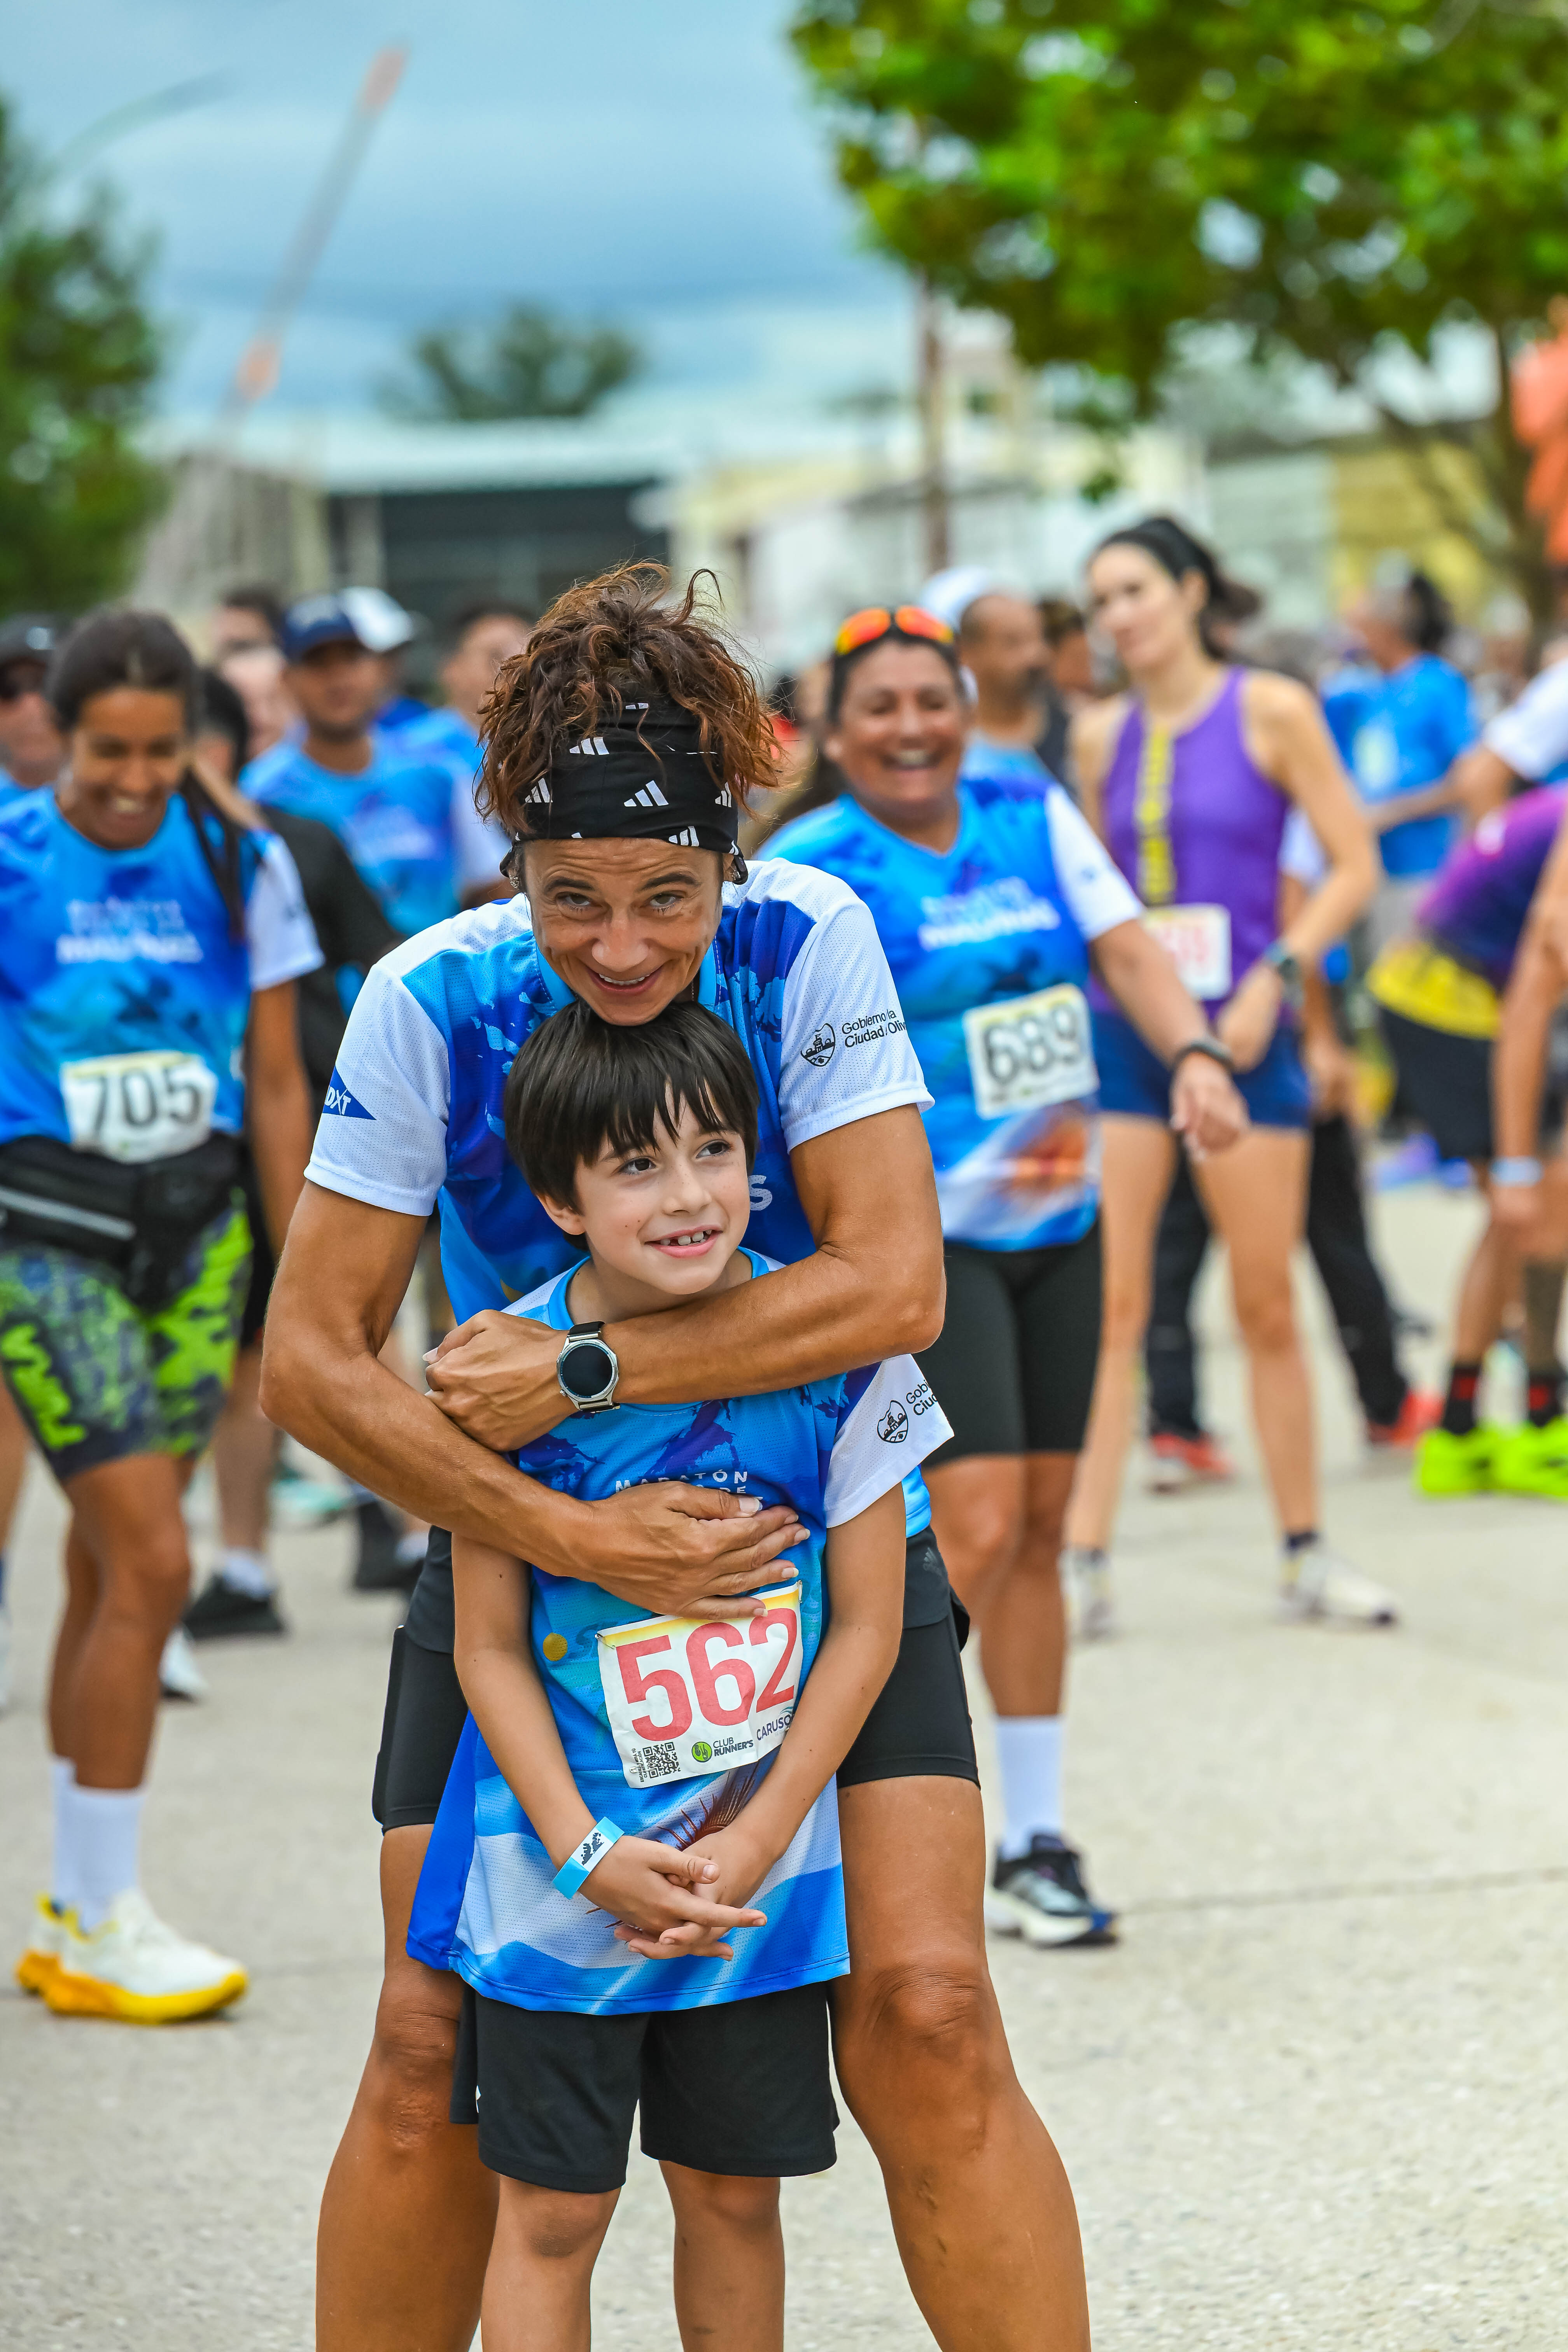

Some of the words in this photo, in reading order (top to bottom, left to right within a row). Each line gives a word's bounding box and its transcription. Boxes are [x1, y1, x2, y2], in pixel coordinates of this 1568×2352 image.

[842, 1013, 886, 1034] Gobierno
[845, 1025, 885, 1048] Ciudad
[981, 1001, 1080, 1085] 689
[72, 1062, 201, 1139] 705
[324, 1085, 352, 1115] DXT
[616, 1608, 798, 1741] 562
[756, 1714, 791, 1741] CARUSO
[713, 1737, 734, 1748] CLUB
